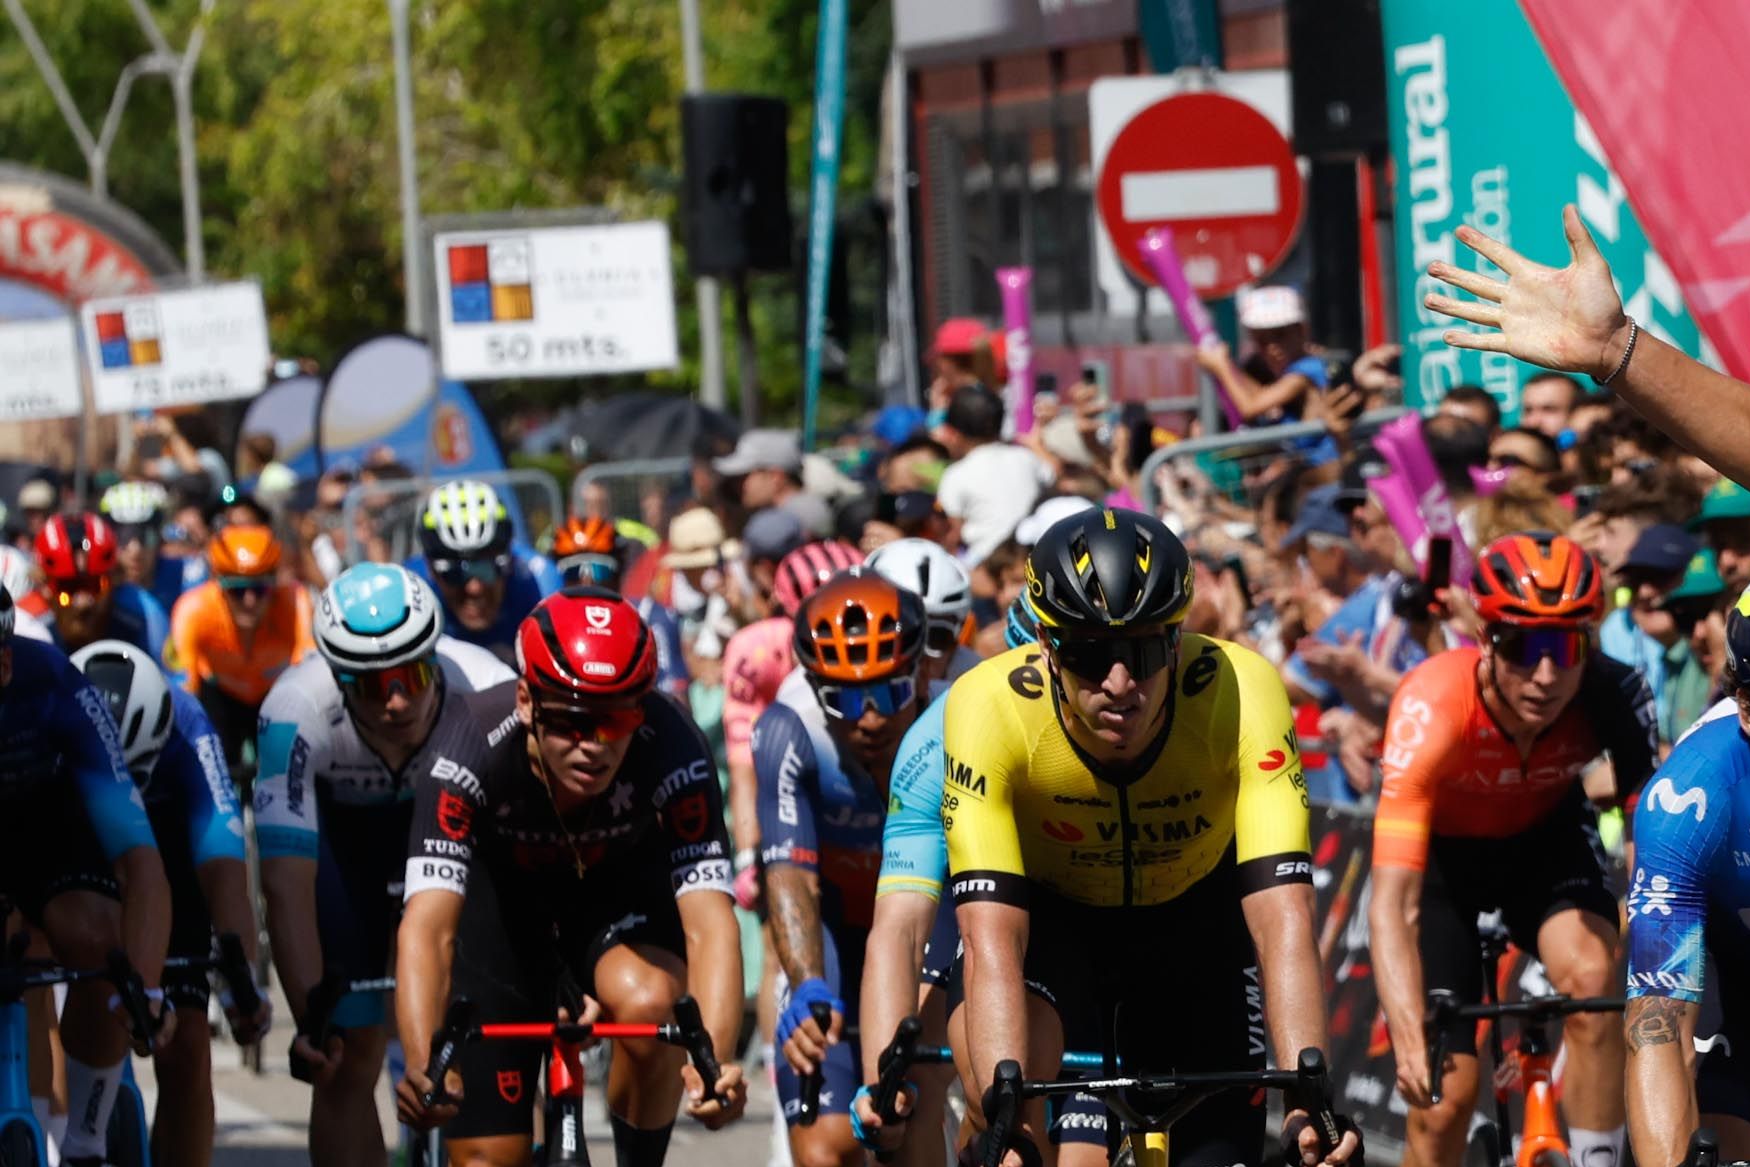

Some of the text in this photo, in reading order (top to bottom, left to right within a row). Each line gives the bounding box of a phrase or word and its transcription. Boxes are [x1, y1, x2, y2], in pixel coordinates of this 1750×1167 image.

[1395, 33, 1466, 417] ajarural
[486, 334, 533, 364] 50
[1381, 697, 1433, 798] INEOS
[777, 741, 804, 826] GIANT
[424, 839, 471, 859] TUDO
[422, 863, 466, 885] BOS
[1243, 966, 1266, 1056] VISMA
[1089, 1078, 1134, 1088] cervélo
[1320, 1110, 1340, 1145] SRA
